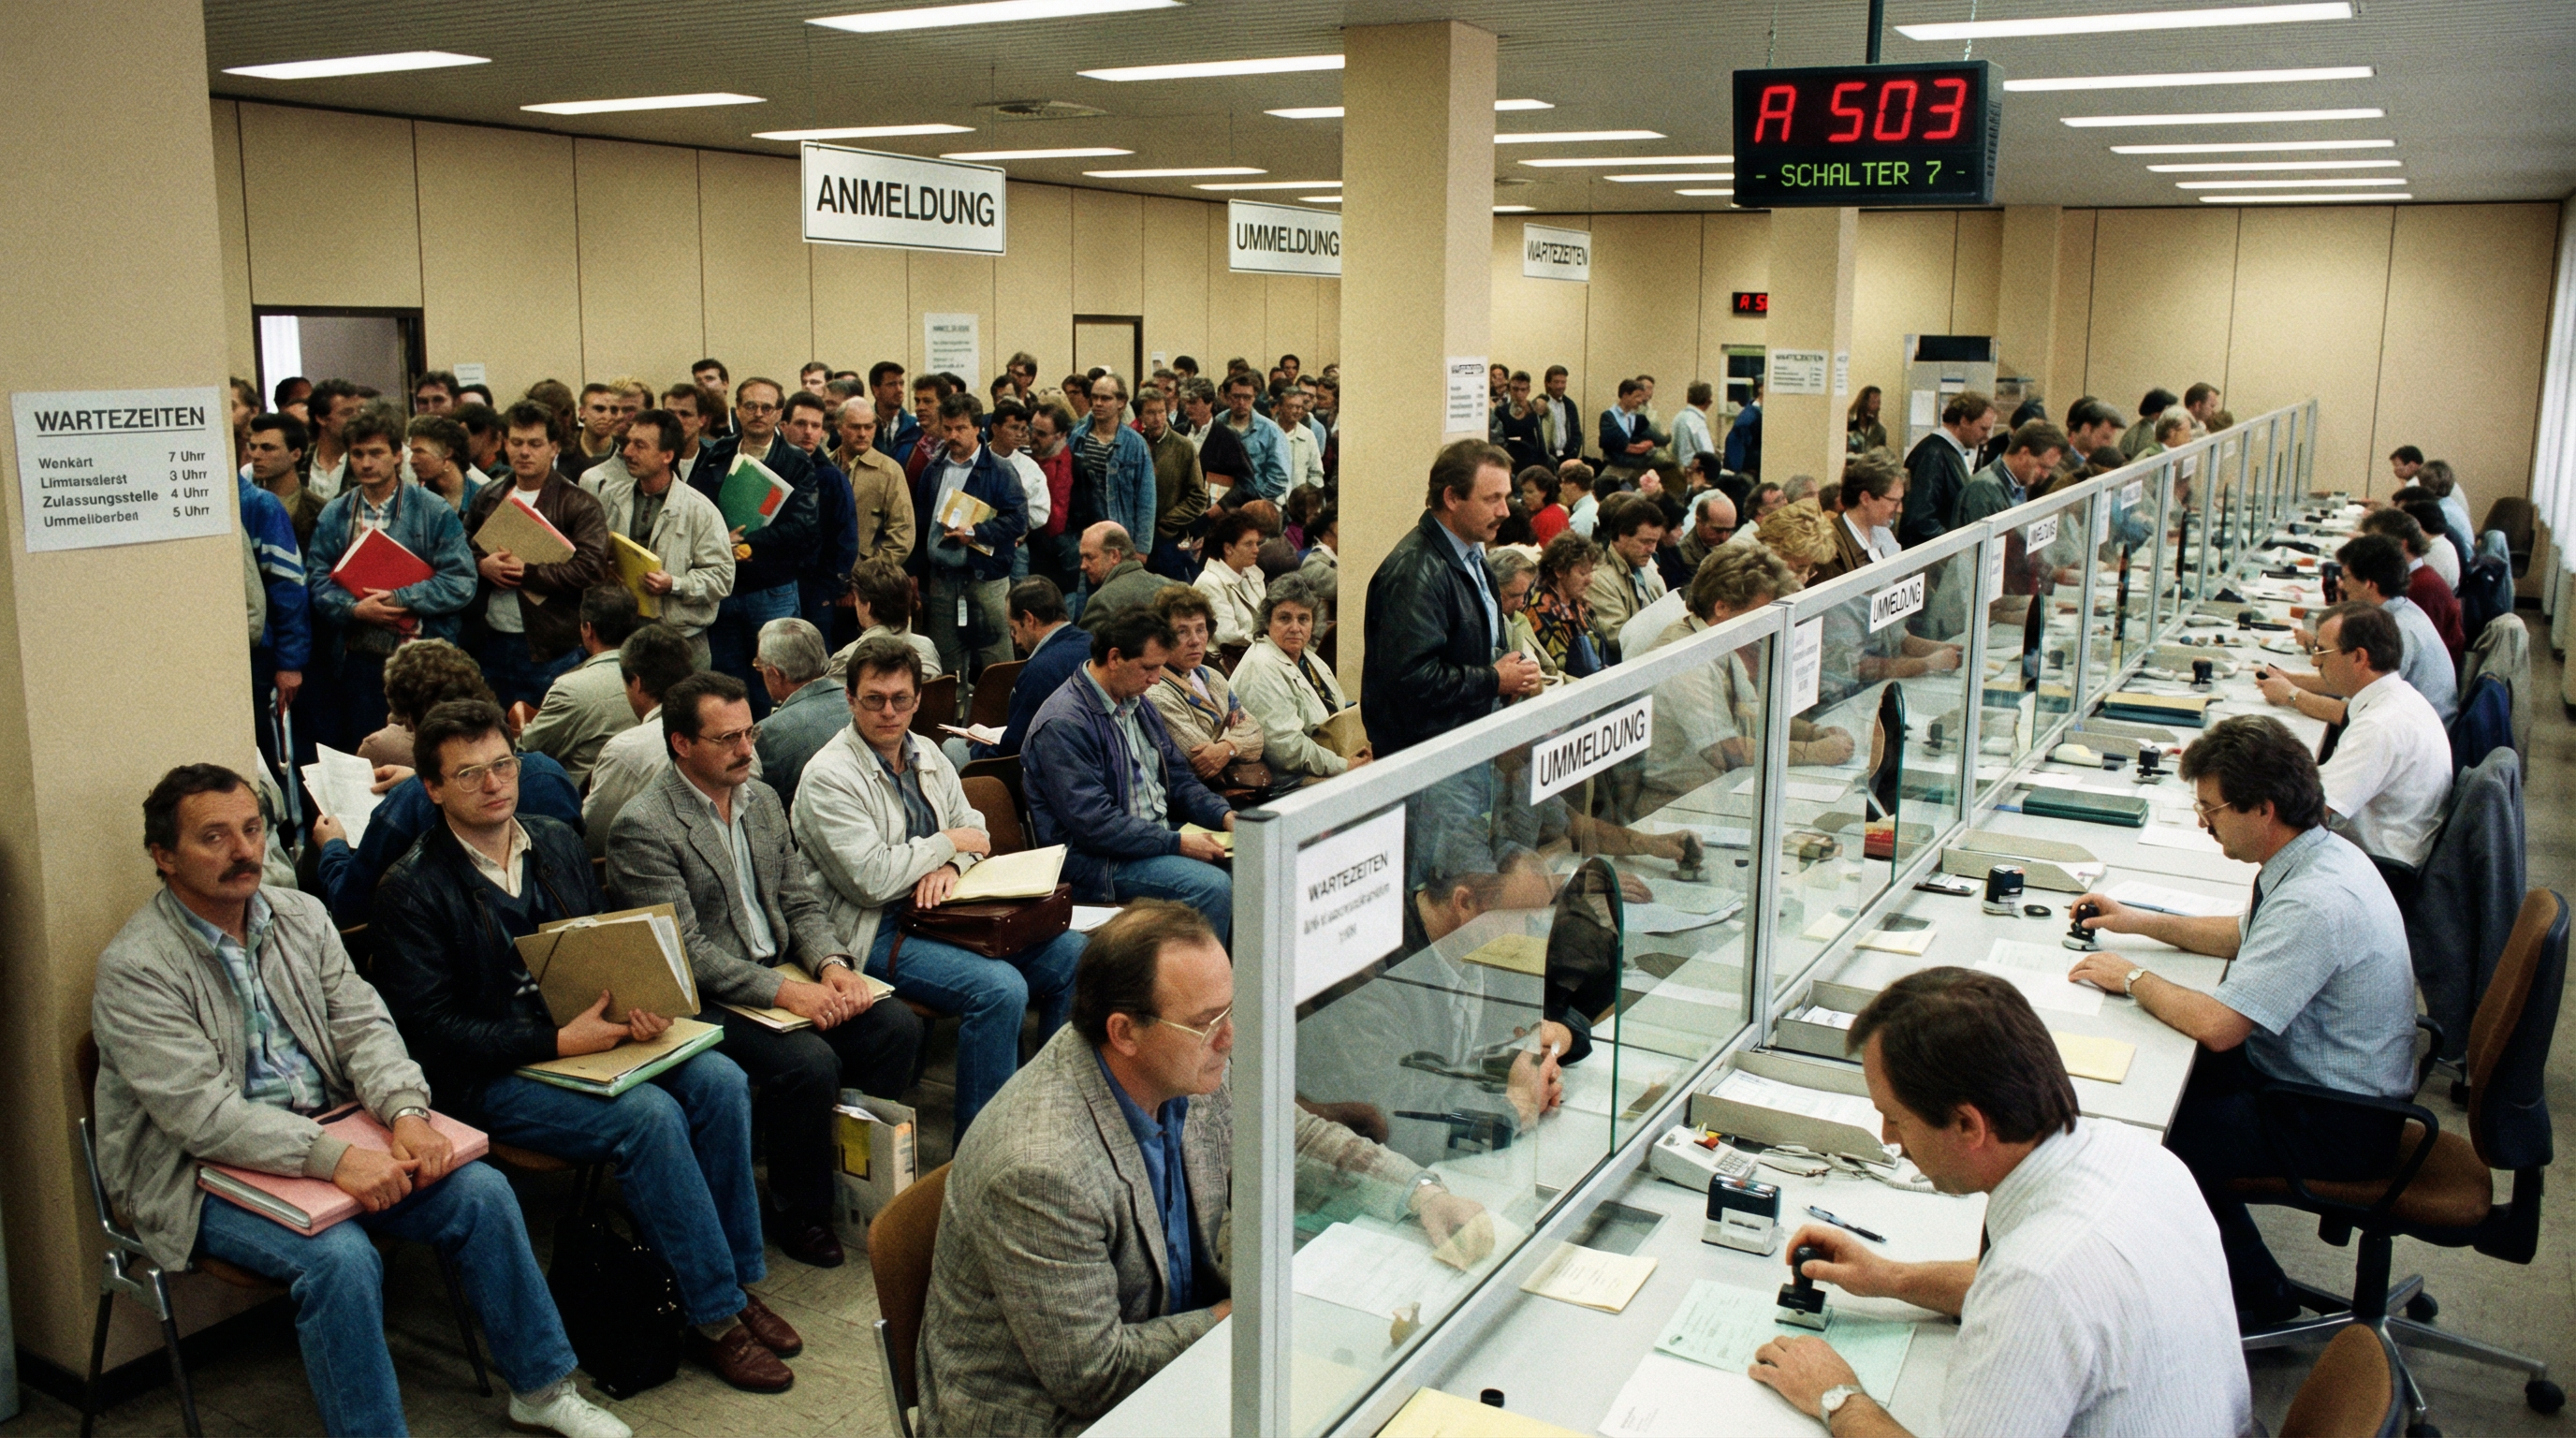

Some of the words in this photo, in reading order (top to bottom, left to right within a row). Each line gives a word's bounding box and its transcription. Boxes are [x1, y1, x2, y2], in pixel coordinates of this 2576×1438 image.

[1753, 84, 1797, 143] A
[1780, 161, 1910, 187] SCHALTER
[1925, 160, 1942, 184] 7
[816, 174, 995, 227] ANMELDUNG
[1237, 222, 1339, 257] UMMELDUNG
[34, 406, 206, 432] WARTEZEITEN
[168, 451, 176, 462] 7
[169, 470, 178, 481] 3
[42, 490, 159, 508] Zulassungsstelle
[170, 488, 179, 498] 4
[173, 506, 181, 518] 5
[1540, 709, 1645, 786] UMMELDUNG
[1309, 850, 1389, 902] WARTEZEITEN
